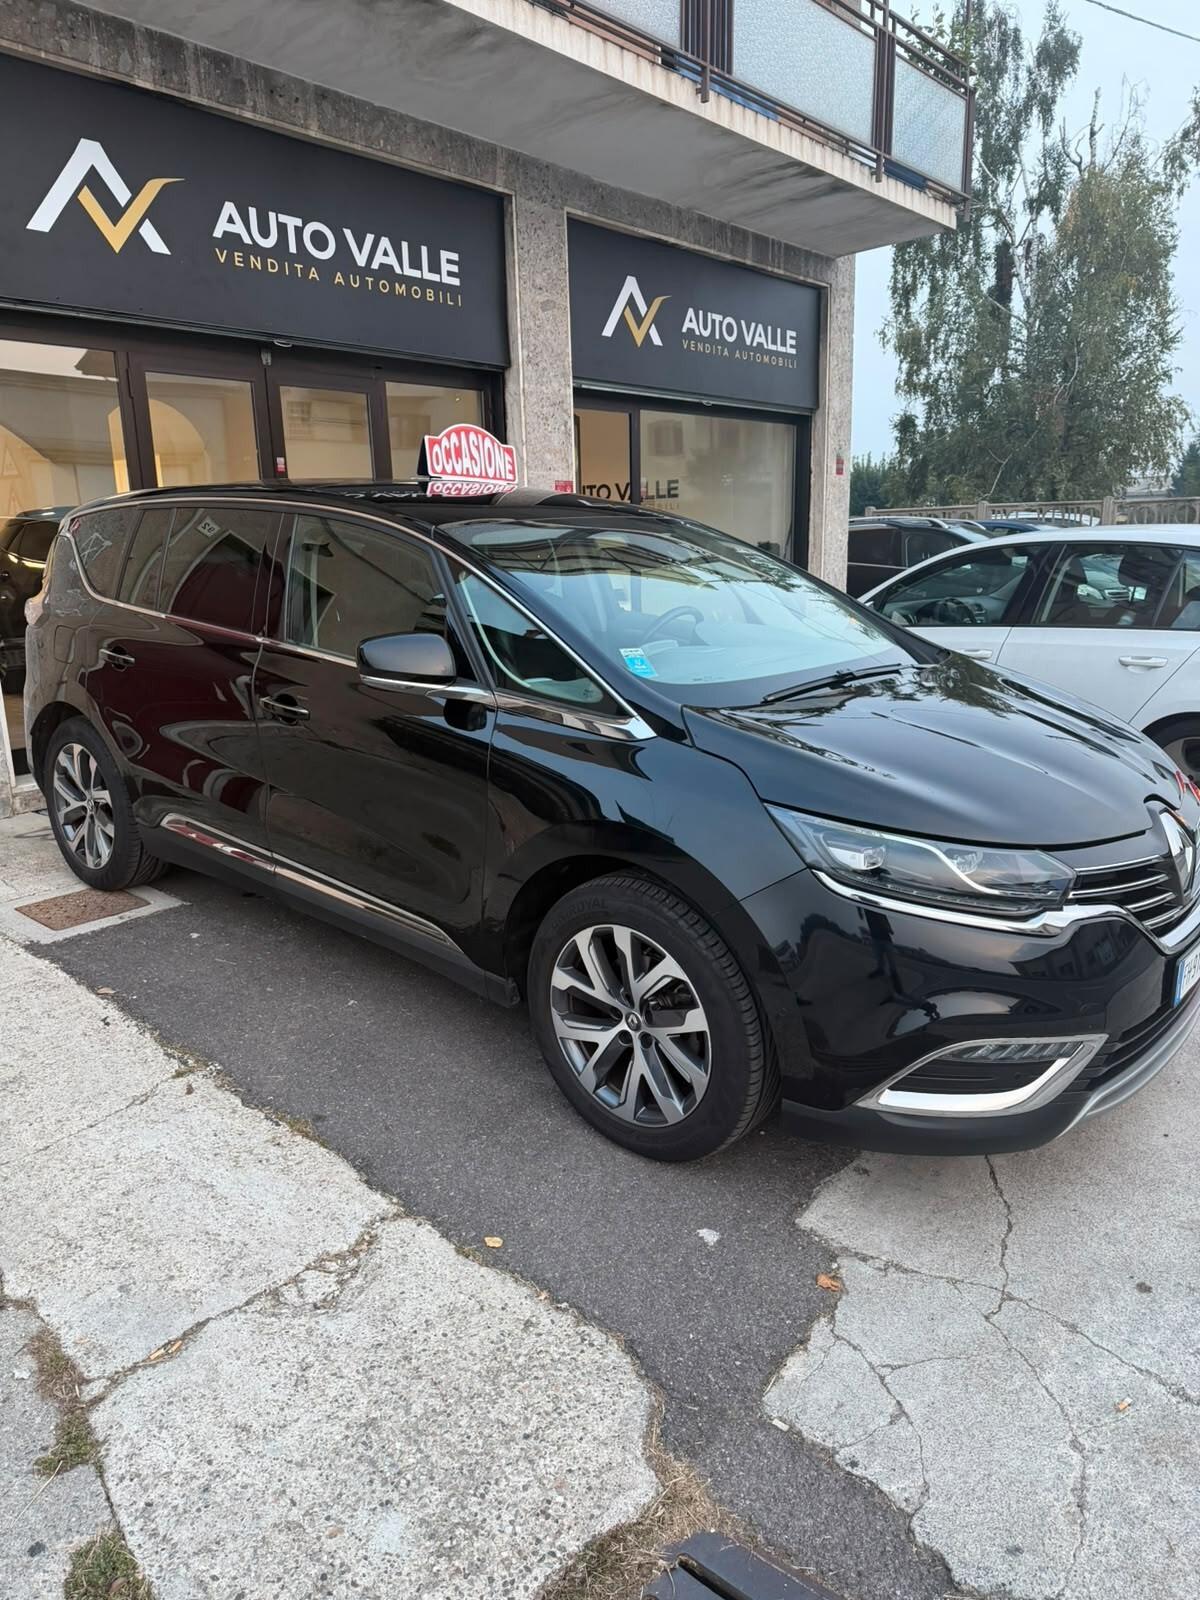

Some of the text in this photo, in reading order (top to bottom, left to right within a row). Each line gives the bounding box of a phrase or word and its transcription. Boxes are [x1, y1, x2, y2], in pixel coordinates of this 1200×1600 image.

[212, 200, 461, 287] AUTO VALLE
[214, 247, 463, 308] VENDITA AUTOMOBILI
[681, 307, 797, 355] AUTO VALLE
[682, 338, 797, 369] VENDITA AUTOMOBILI
[432, 431, 514, 480] OCCASIONE
[614, 478, 680, 501] VLLE
